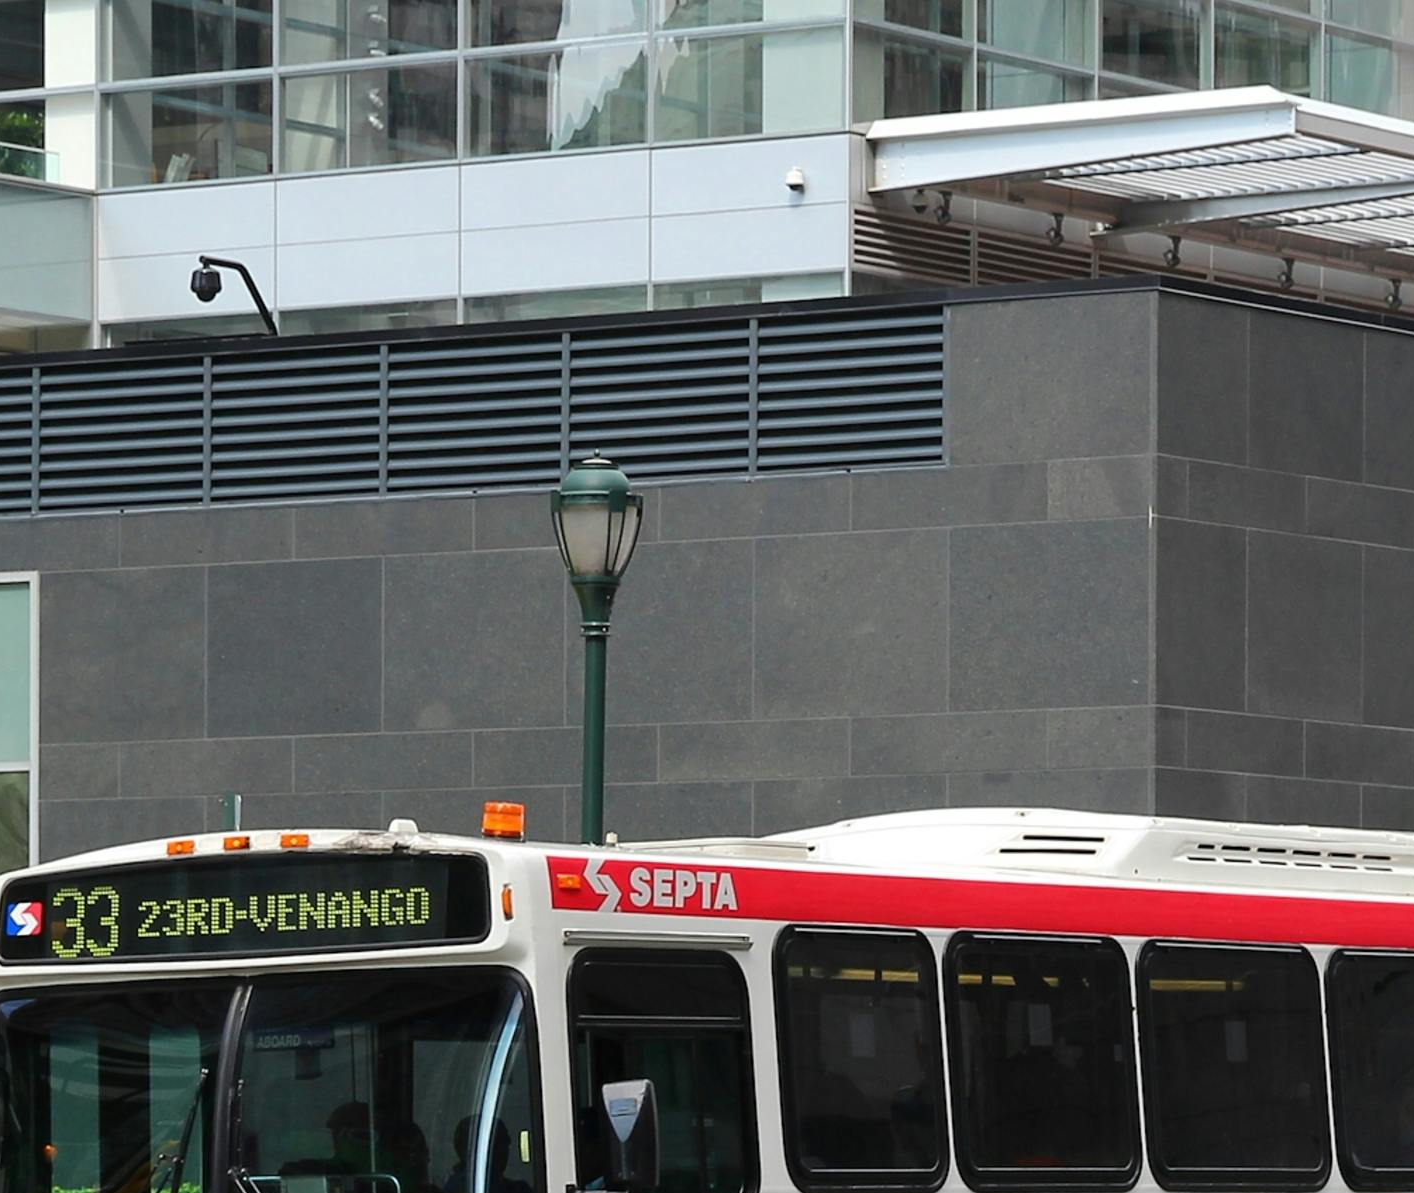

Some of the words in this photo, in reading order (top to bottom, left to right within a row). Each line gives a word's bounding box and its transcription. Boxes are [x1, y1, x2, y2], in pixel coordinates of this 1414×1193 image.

[629, 868, 739, 912] SEPTA
[51, 886, 120, 957] 33
[138, 886, 431, 938] 23RD-VENANGO
